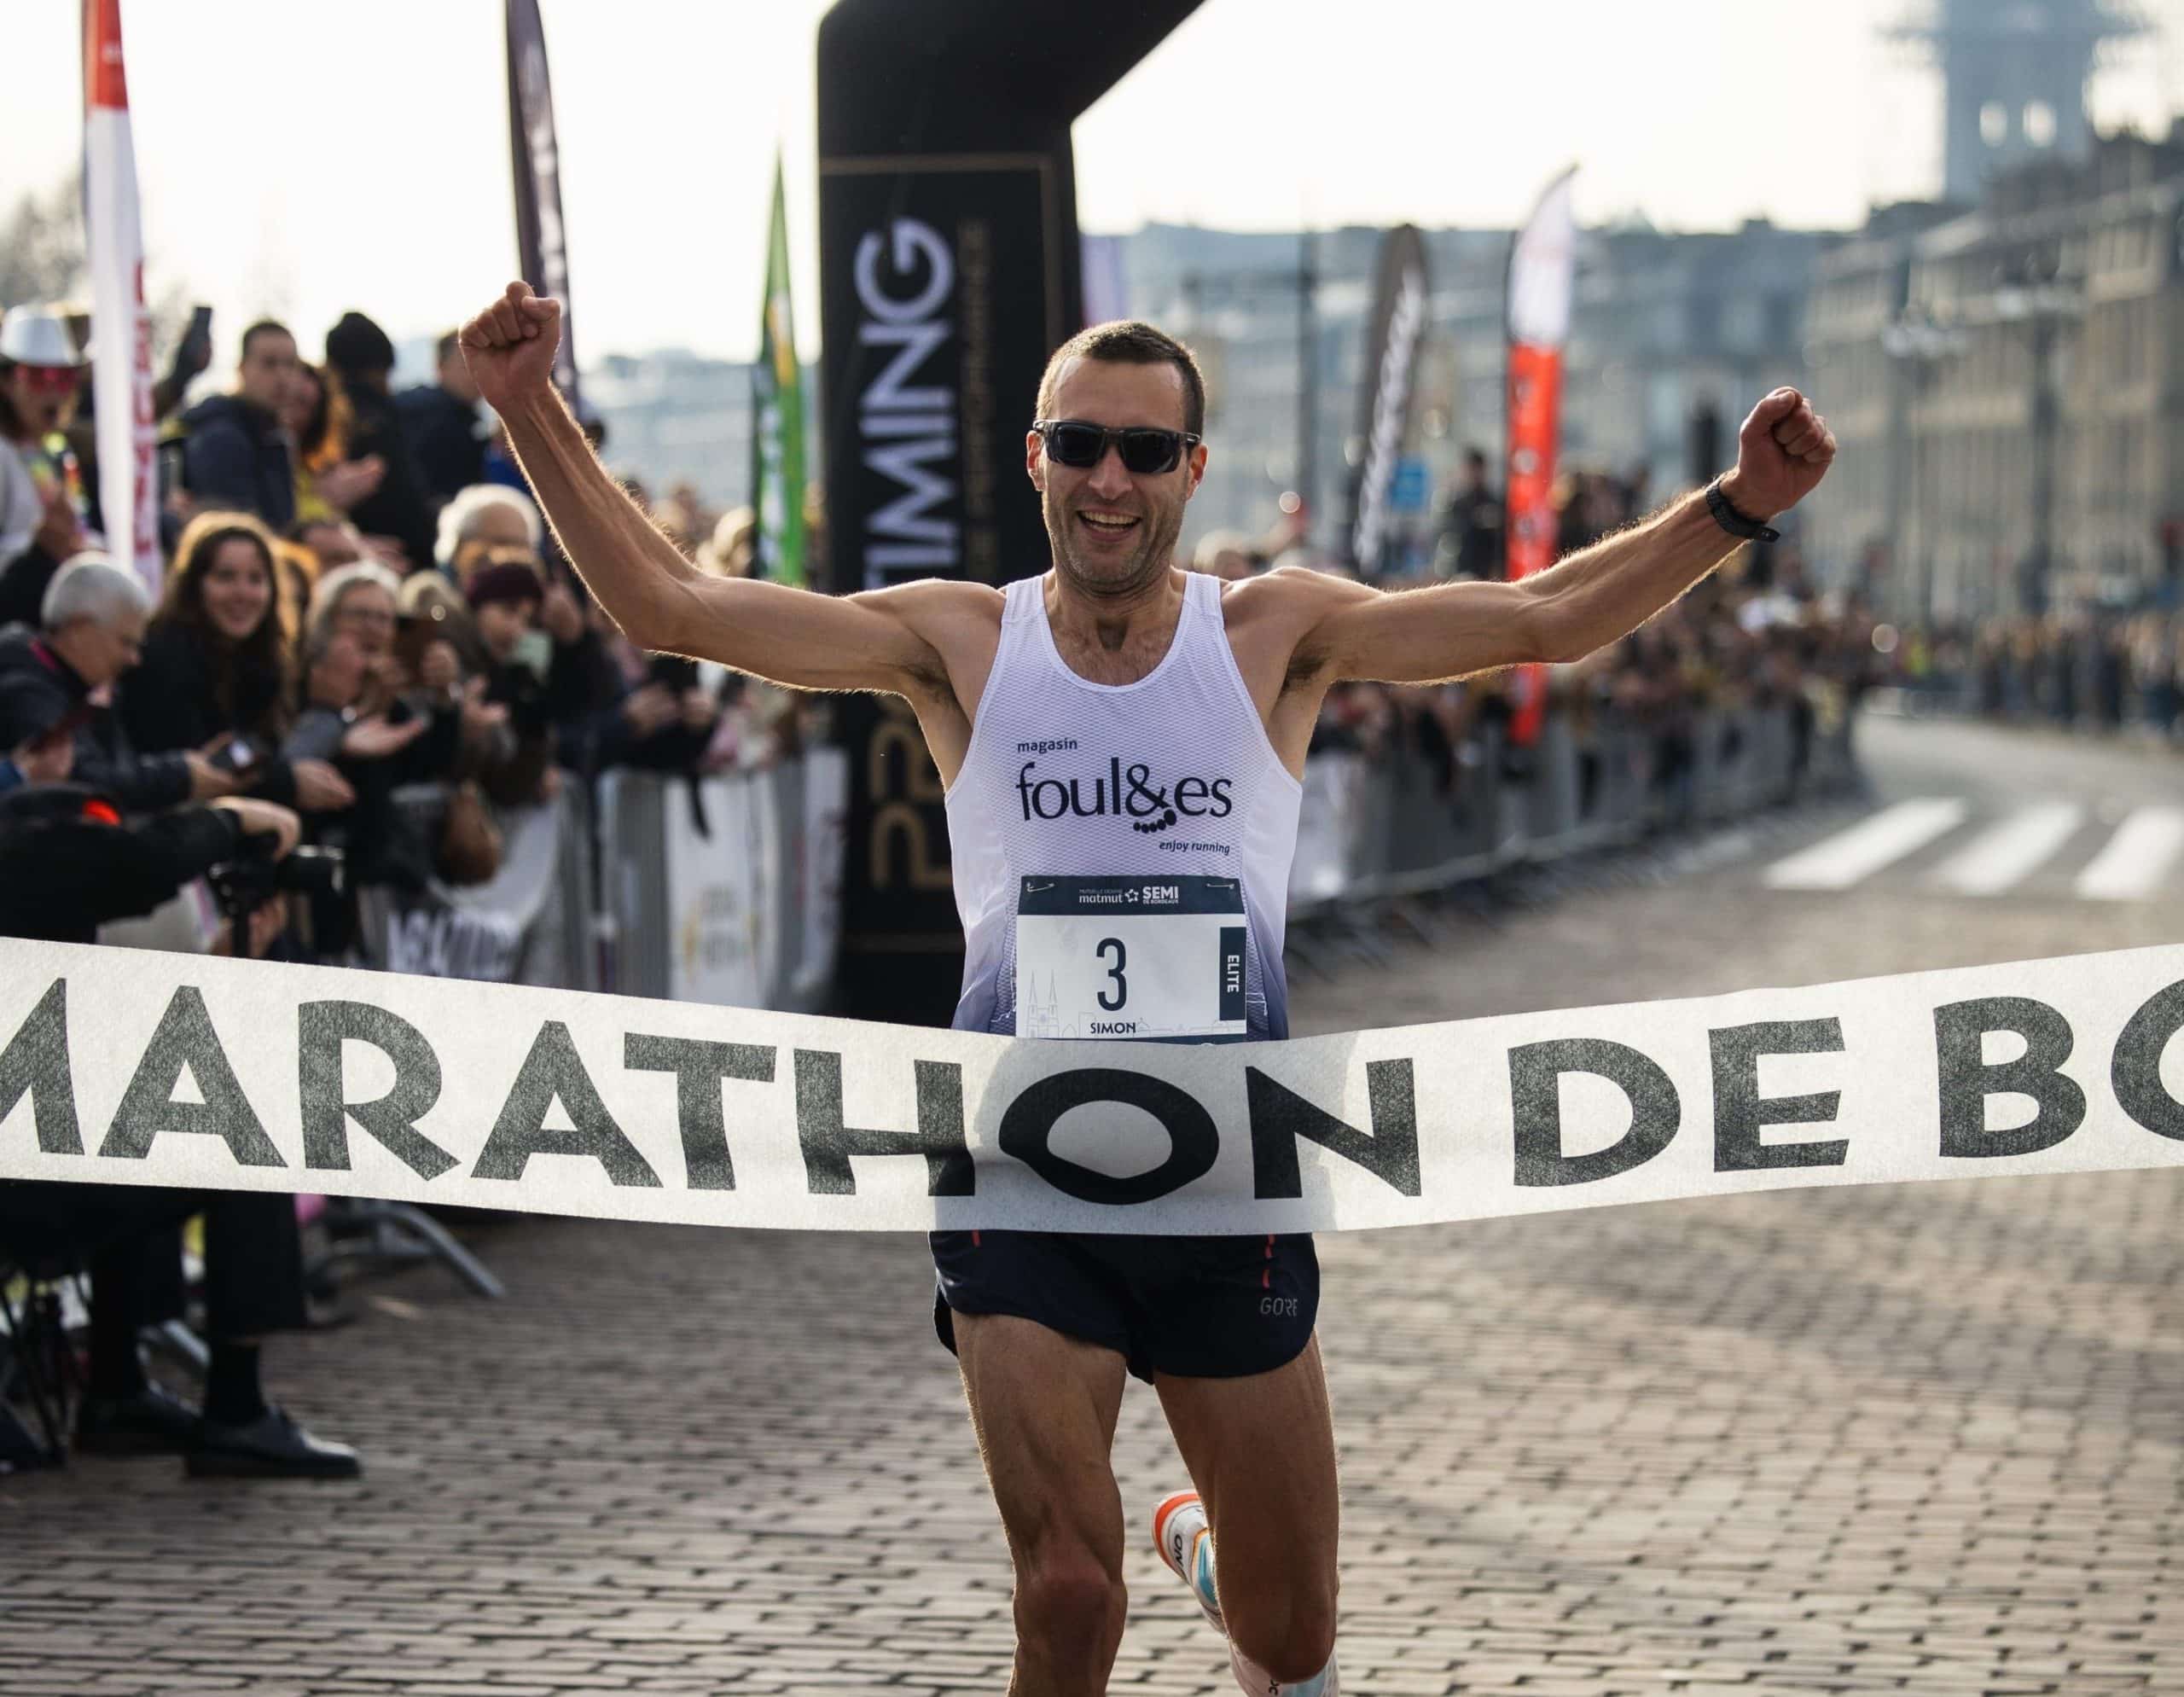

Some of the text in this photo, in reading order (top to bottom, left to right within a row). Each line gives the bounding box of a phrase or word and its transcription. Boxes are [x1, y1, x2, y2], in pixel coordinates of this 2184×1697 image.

[1017, 738, 1078, 754] magasin
[868, 695, 952, 892] PR
[1159, 840, 1230, 854] enjoy running
[1079, 886, 1179, 904] matmut SEMI
[1095, 938, 1127, 1012] 3
[1227, 955, 1240, 993] ELITE
[1090, 1022, 1136, 1034] SIMON
[1507, 1016, 1850, 1187] DE
